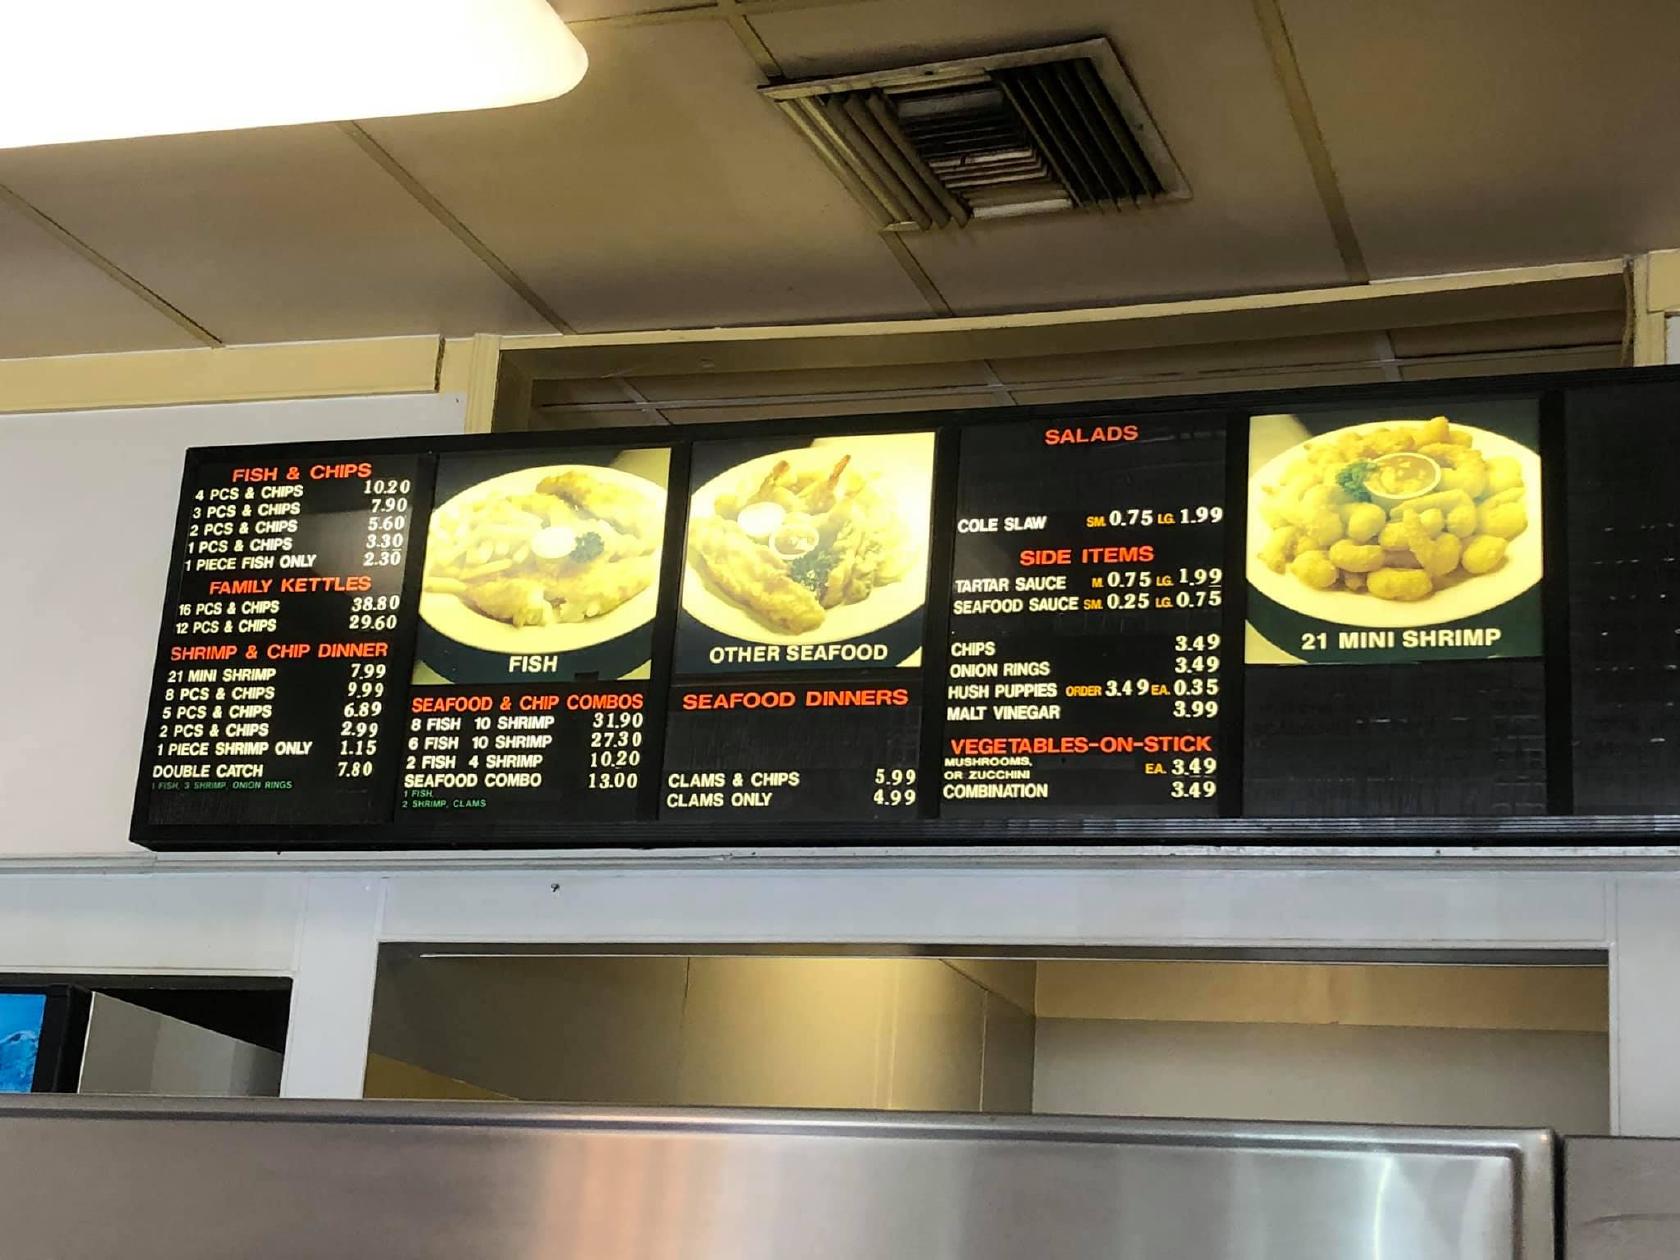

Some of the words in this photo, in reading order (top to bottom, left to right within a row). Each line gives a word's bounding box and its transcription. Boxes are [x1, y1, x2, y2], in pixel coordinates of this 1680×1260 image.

[1045, 425, 1138, 445] SALADS
[233, 467, 278, 482] FISH
[286, 467, 300, 480] &
[310, 463, 372, 479] CHIPS
[195, 490, 204, 501] 4
[210, 487, 239, 500] PCS
[245, 487, 254, 499] &
[261, 484, 303, 499] CHIPS
[364, 480, 410, 494] 10.20
[193, 507, 201, 519] 3
[207, 505, 236, 518] PCS
[242, 504, 252, 516] &
[258, 502, 300, 516] CHIPS
[372, 497, 407, 513] 7.90
[190, 524, 199, 536] 2
[204, 522, 233, 536] PCS
[239, 522, 249, 534] &
[255, 519, 298, 534] CHIPS
[368, 515, 405, 531] 5.60
[957, 518, 998, 533] COLE
[1004, 516, 1047, 531] SLAW
[1109, 509, 1153, 526] 0.75
[1180, 507, 1223, 523] 1.99
[189, 542, 194, 554] 1
[199, 540, 228, 553] PCS
[234, 539, 244, 552] &
[249, 537, 293, 551] CHIPS
[366, 533, 404, 549] 3.30
[185, 560, 191, 571] 1
[196, 558, 237, 571] PIECE
[241, 556, 274, 569] FISH
[280, 554, 317, 568] ONLY
[363, 549, 402, 566] 2.30
[1020, 549, 1071, 566] SIDE
[1082, 546, 1154, 563] ITEMS
[210, 579, 272, 594] FAMILY
[281, 576, 372, 592] KETTLES
[955, 578, 1009, 593] TARTAR
[1015, 576, 1066, 591] SAUCE
[1107, 572, 1151, 587] 0.75
[1180, 568, 1222, 587] 1.99
[179, 604, 191, 616] 16
[196, 602, 222, 615] PCS
[227, 602, 236, 614] &
[241, 600, 280, 614] CHIPS
[352, 595, 400, 612] 38.80
[953, 599, 1023, 615] SEAFOOD
[1029, 596, 1079, 612] SAUCE
[1107, 593, 1149, 609] 0.25
[1176, 591, 1221, 607] 0.75
[176, 622, 189, 634] 12
[193, 620, 219, 634] PCS
[224, 620, 233, 633] &
[238, 618, 276, 633] CHIPS
[349, 615, 397, 630] 29.60
[951, 641, 995, 657] CHIPS
[1175, 633, 1220, 651] 3.49
[1302, 633, 1326, 650] 21
[1339, 631, 1394, 649] MINI
[1402, 628, 1501, 648] SHRIMP
[171, 645, 237, 661] SHRIMP
[245, 645, 258, 659] &
[267, 644, 310, 659] CHIP
[318, 642, 388, 658] DINNER
[710, 645, 780, 664] OTHER
[786, 645, 888, 661] SEAFOOD
[167, 670, 183, 683] 21
[188, 669, 217, 682] MINI
[222, 668, 276, 682] SHRIMP
[351, 663, 386, 679] 7.99
[509, 655, 558, 672] FISH
[950, 663, 998, 678] ONION
[1003, 661, 1050, 676] RINGS
[1175, 656, 1219, 673] 3.49
[165, 688, 174, 701] 8
[180, 687, 210, 701] PCS
[215, 687, 225, 700] &
[231, 686, 275, 700] CHIPS
[348, 682, 384, 698] 9.99
[948, 684, 989, 699] HUSH
[995, 683, 1057, 698] PUPPIES
[1066, 685, 1102, 697] ORDER
[1105, 679, 1149, 696] 3.49
[1151, 684, 1170, 695] EA.
[1174, 678, 1219, 696] 0.35
[412, 696, 493, 713] SEAFOOD
[500, 696, 512, 710] &
[520, 696, 559, 710] CHIP
[567, 694, 643, 710] COMBOS
[683, 692, 796, 710] SEAFOOD
[806, 689, 908, 706] DINNERS
[162, 707, 171, 719] 5
[177, 705, 207, 719] PCS
[212, 705, 222, 719] &
[229, 705, 272, 719] CHIPS
[344, 701, 382, 718] 6.89
[947, 706, 987, 720] MALT
[993, 705, 1060, 720] VINEGAR
[1173, 700, 1218, 718] 3.99
[159, 725, 168, 737] 2
[174, 724, 204, 738] PCS
[209, 724, 219, 737] &
[225, 723, 269, 737] CHIPS
[341, 721, 378, 738] 2.99
[411, 718, 421, 731] 8
[427, 717, 461, 731] FISH
[474, 717, 491, 730] 10
[497, 716, 555, 729] SHRIMP
[593, 712, 643, 728] 31.90
[158, 744, 163, 756] 1
[168, 742, 209, 756] PIECE
[215, 742, 269, 756] SHRIMP
[275, 741, 313, 755] ONLY
[340, 740, 376, 755] 1.15
[408, 737, 418, 750] 6
[424, 736, 459, 750] FISH
[472, 736, 489, 749] 10
[495, 735, 552, 749] SHRIMP
[591, 731, 642, 747] 27.30
[153, 765, 211, 778] DOUBLE
[216, 764, 263, 778] CATCH
[338, 761, 372, 777] 7.80
[406, 756, 416, 769] 2
[422, 755, 456, 769] FISH
[469, 755, 479, 768] 4
[486, 754, 543, 769] SHRIMP
[591, 750, 640, 769] 10.20
[944, 771, 963, 780] OR
[968, 770, 1030, 779] ZUCCHINI
[1145, 763, 1167, 774] EA.
[1171, 757, 1216, 775] 3.49
[404, 773, 478, 788] SEAFOOD
[484, 773, 542, 787] COMBO
[589, 773, 637, 789] 13.00
[668, 773, 725, 788] CLAMS
[732, 773, 743, 787] &
[751, 772, 800, 787] CHIPS
[875, 768, 916, 785] 5.99
[667, 793, 724, 808] CLAMS
[731, 792, 772, 806] ONLY
[874, 789, 916, 806] 4.99
[943, 783, 1048, 799] COMBINATION
[1171, 781, 1216, 798] 3.49
